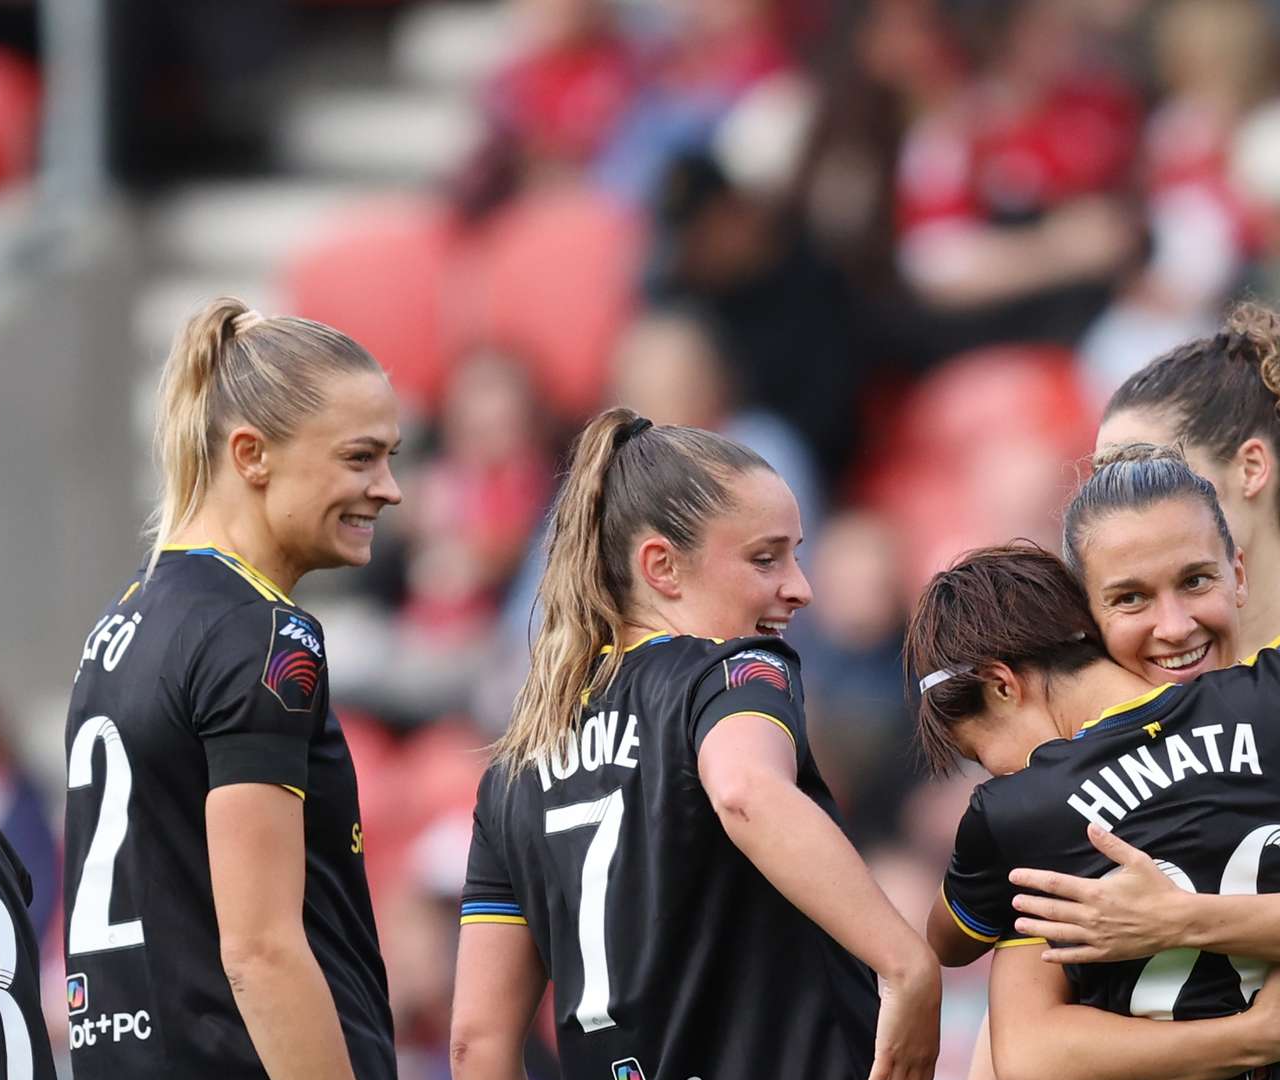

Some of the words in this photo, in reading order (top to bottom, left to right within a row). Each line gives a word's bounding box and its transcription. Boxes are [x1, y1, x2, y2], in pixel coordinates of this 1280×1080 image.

[68, 715, 145, 955] 2
[1067, 723, 1263, 833] HINATA
[545, 787, 624, 1034] 7
